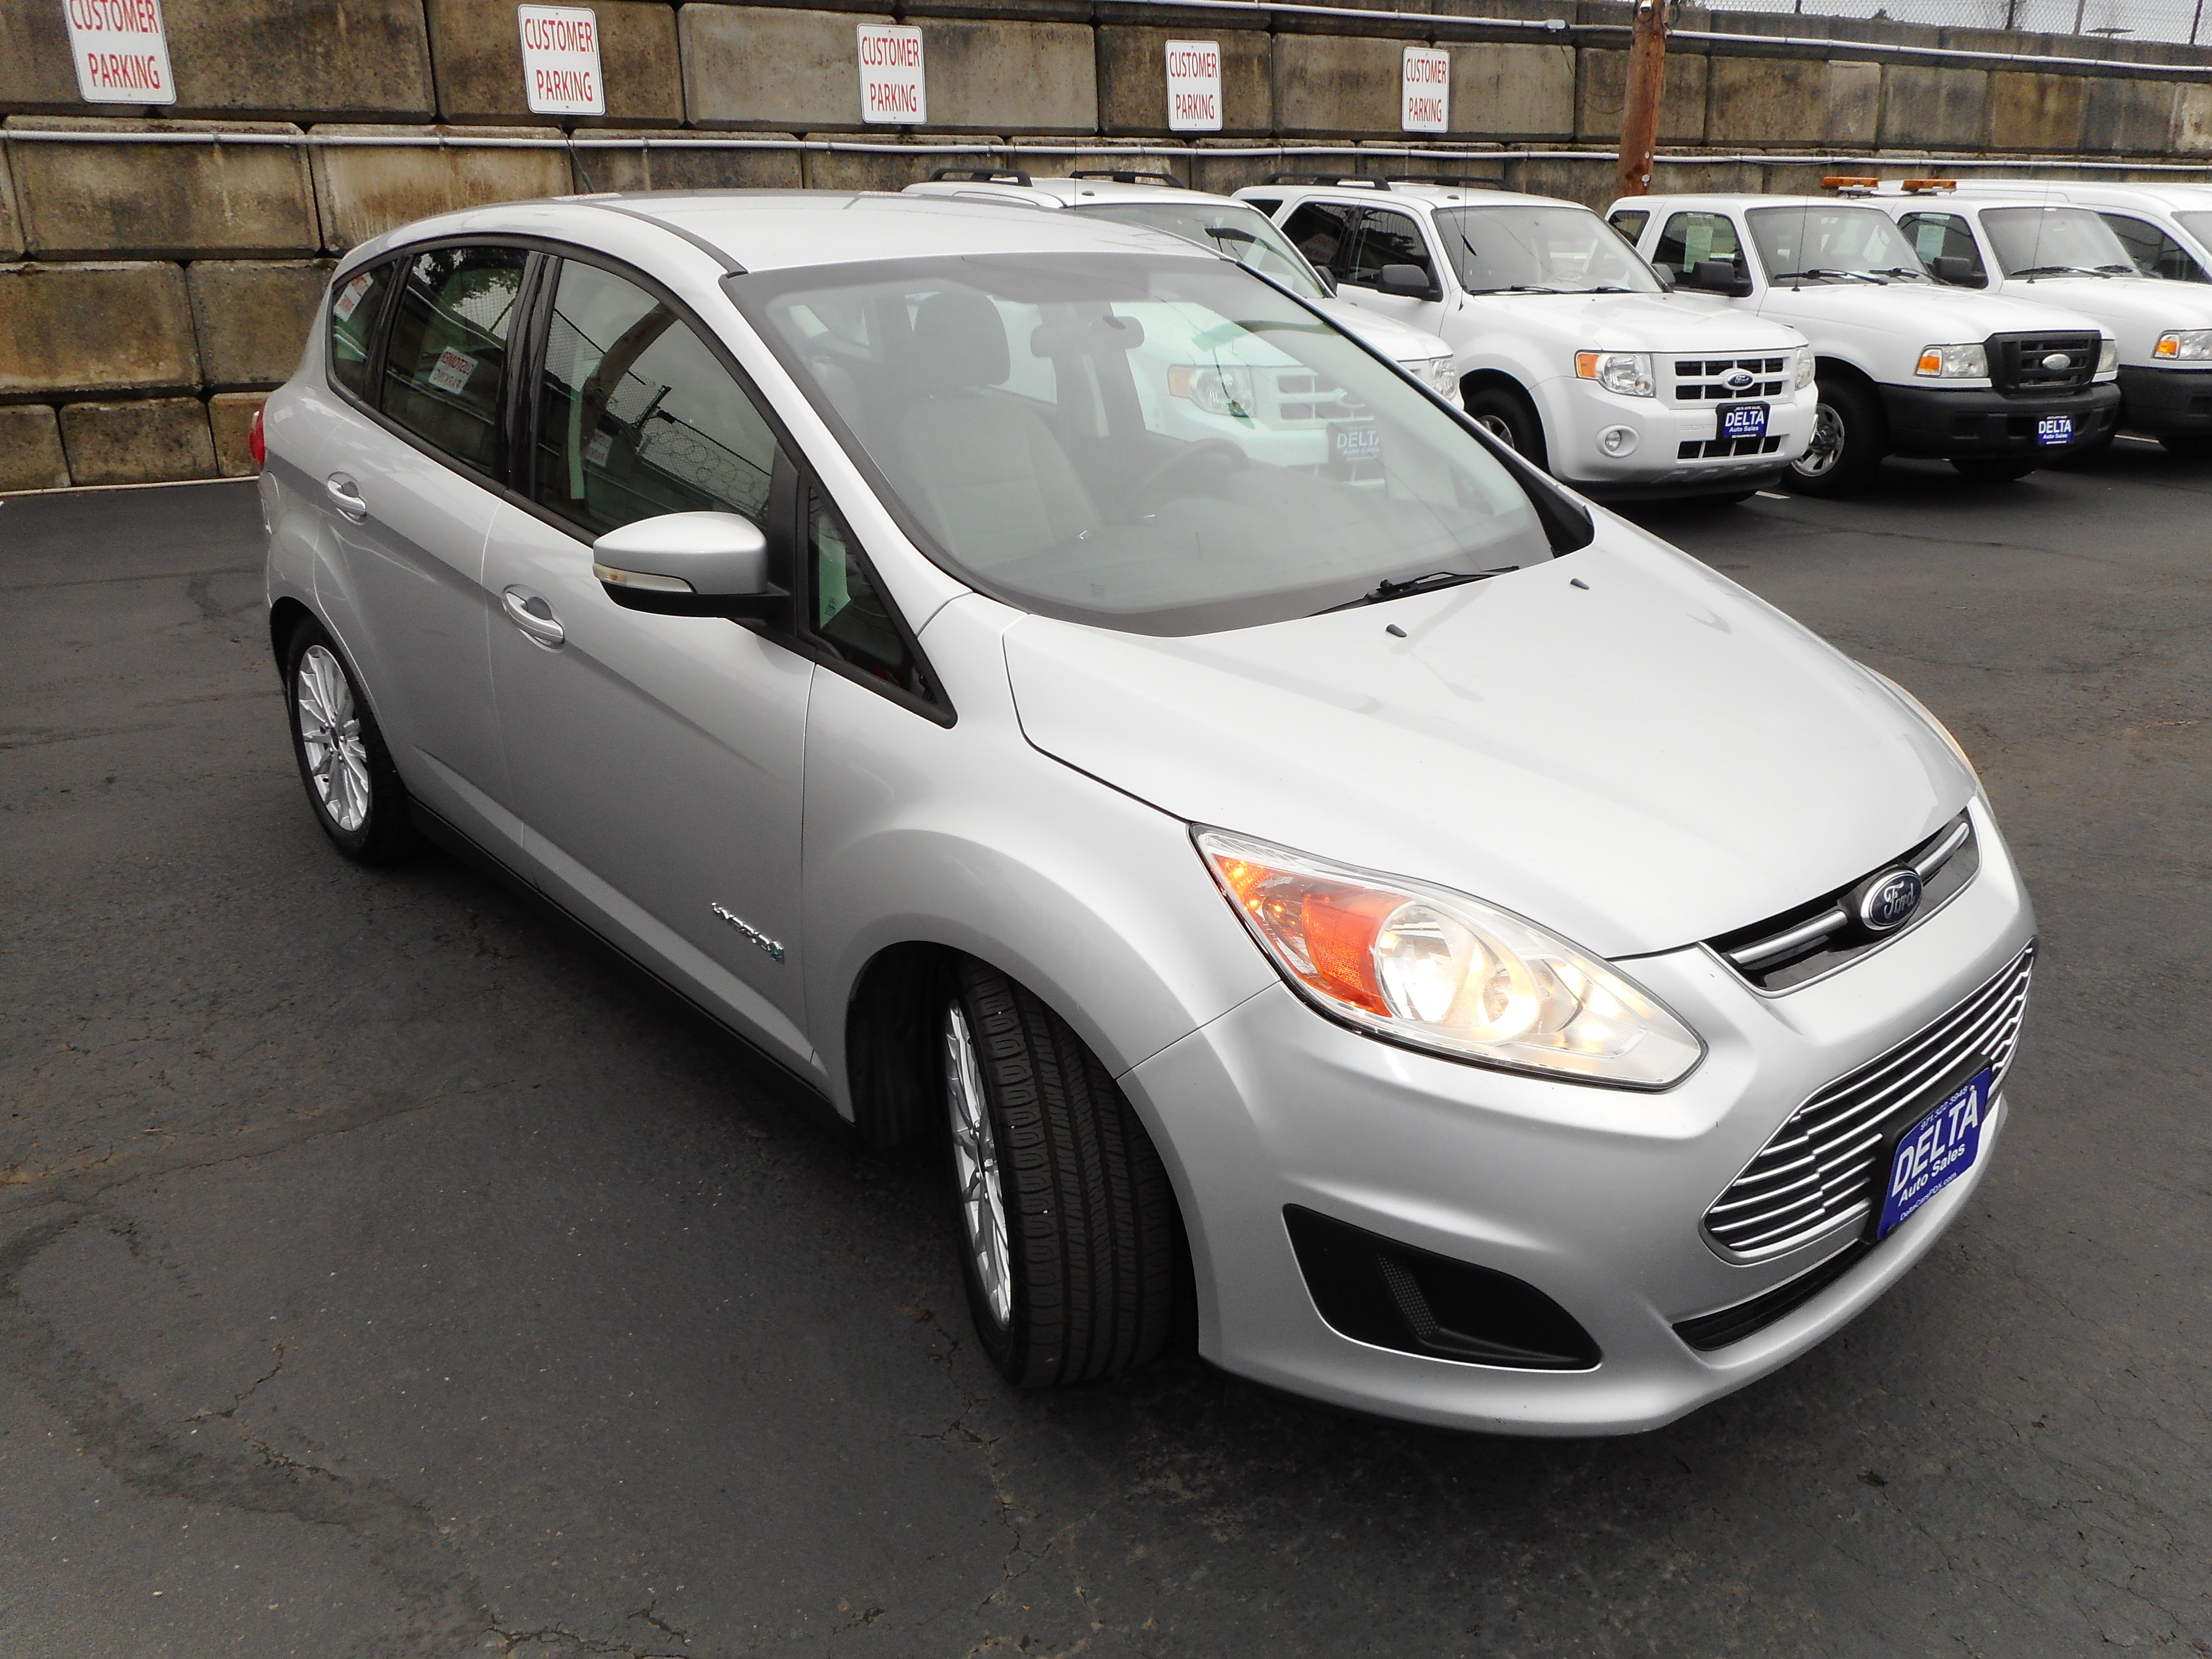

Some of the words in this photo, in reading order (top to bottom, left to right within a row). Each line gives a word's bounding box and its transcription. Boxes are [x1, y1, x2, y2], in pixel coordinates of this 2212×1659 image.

[70, 0, 159, 33] CUSTOMER
[525, 18, 594, 52] CUSTOMER
[862, 36, 920, 67] CUSTOMER
[1169, 52, 1218, 78] CUSTOMER
[88, 53, 161, 89] PARKING
[536, 69, 593, 102] PARKING
[1406, 58, 1447, 84] CUSTOMER
[869, 83, 917, 112] PARKING
[1176, 94, 1215, 120] PARKING
[1409, 97, 1442, 122] PARKING
[1725, 410, 1765, 427] DELTA
[2038, 419, 2072, 434] DELTA
[1883, 880, 1915, 919] Ford
[1891, 1090, 1978, 1198] DELTA
[1897, 1173, 1929, 1207] Auto
[1931, 1143, 1966, 1177] Sales
